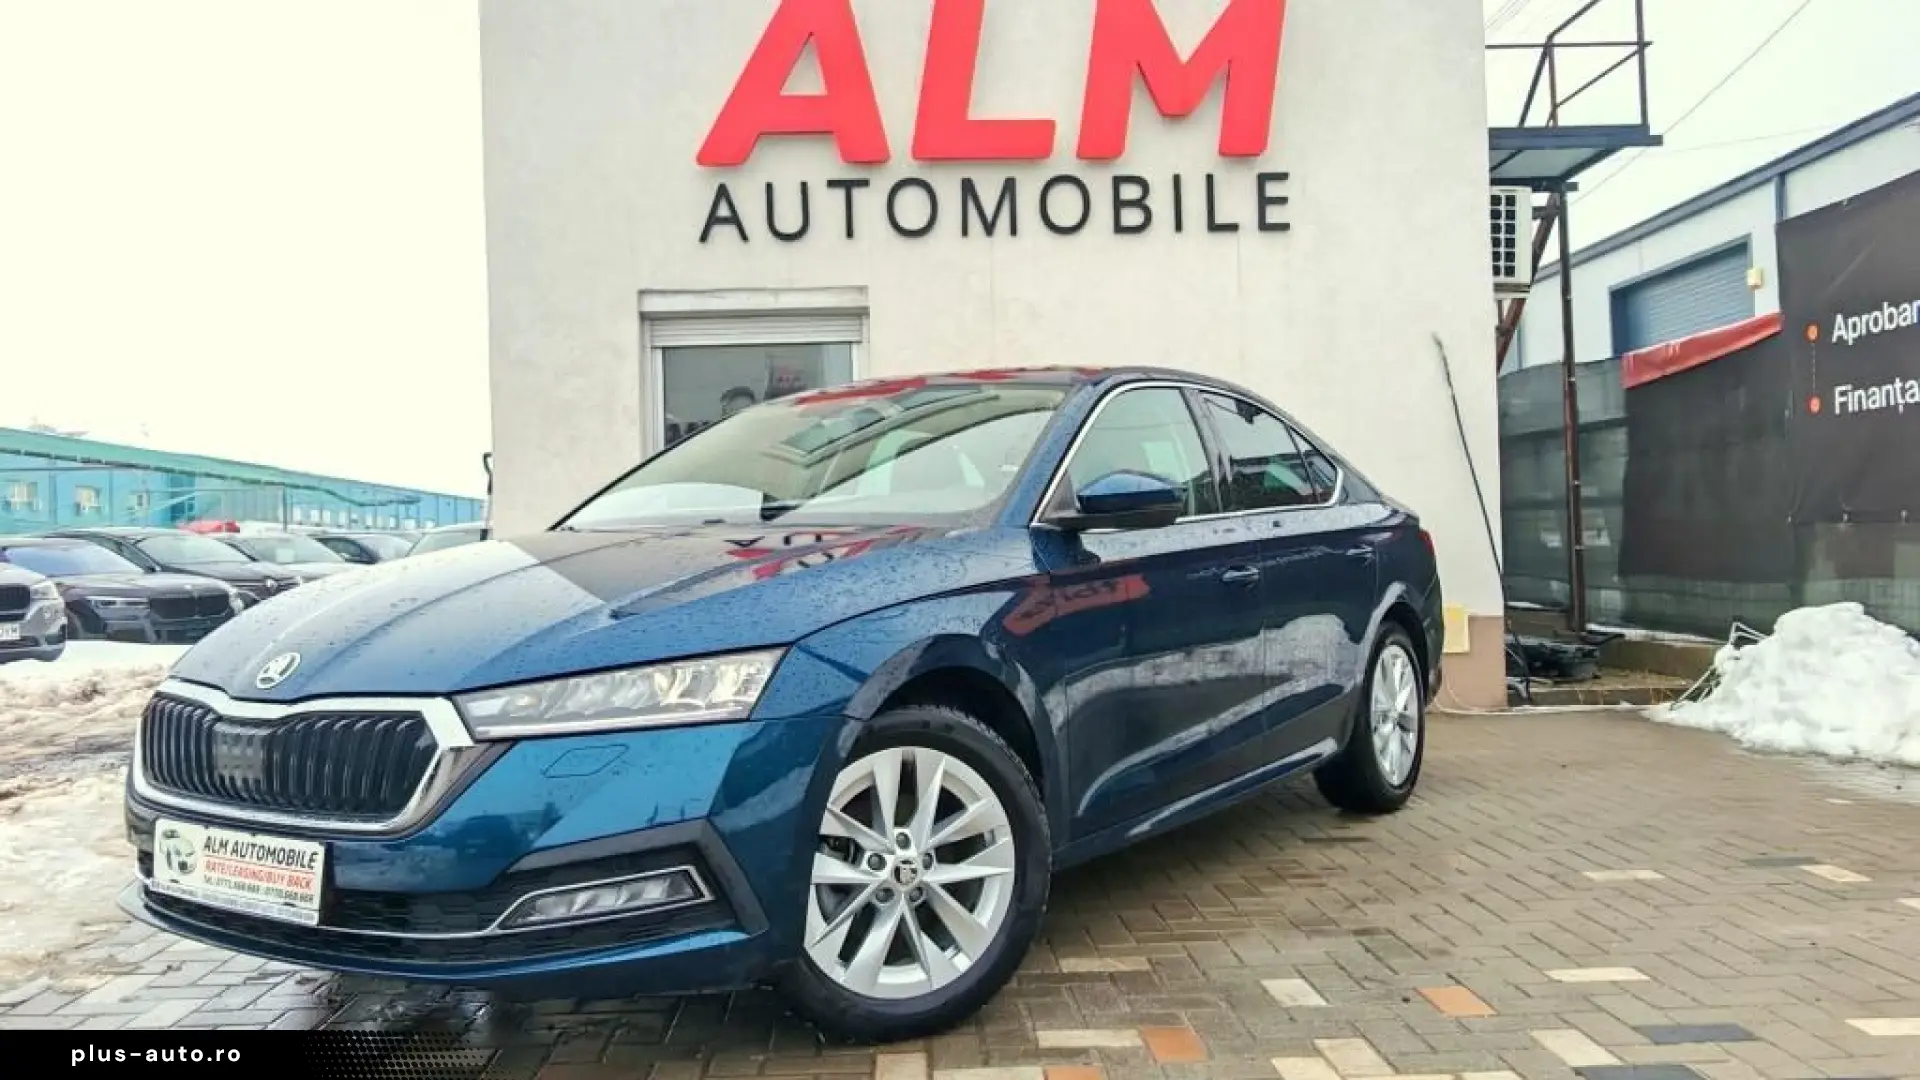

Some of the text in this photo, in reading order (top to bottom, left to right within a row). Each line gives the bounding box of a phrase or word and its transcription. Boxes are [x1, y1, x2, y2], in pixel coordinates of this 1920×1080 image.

[695, 0, 1286, 166] ALM
[699, 171, 1291, 244] AUTOMOBILE
[203, 835, 319, 869] ALM AUTOMOBILE
